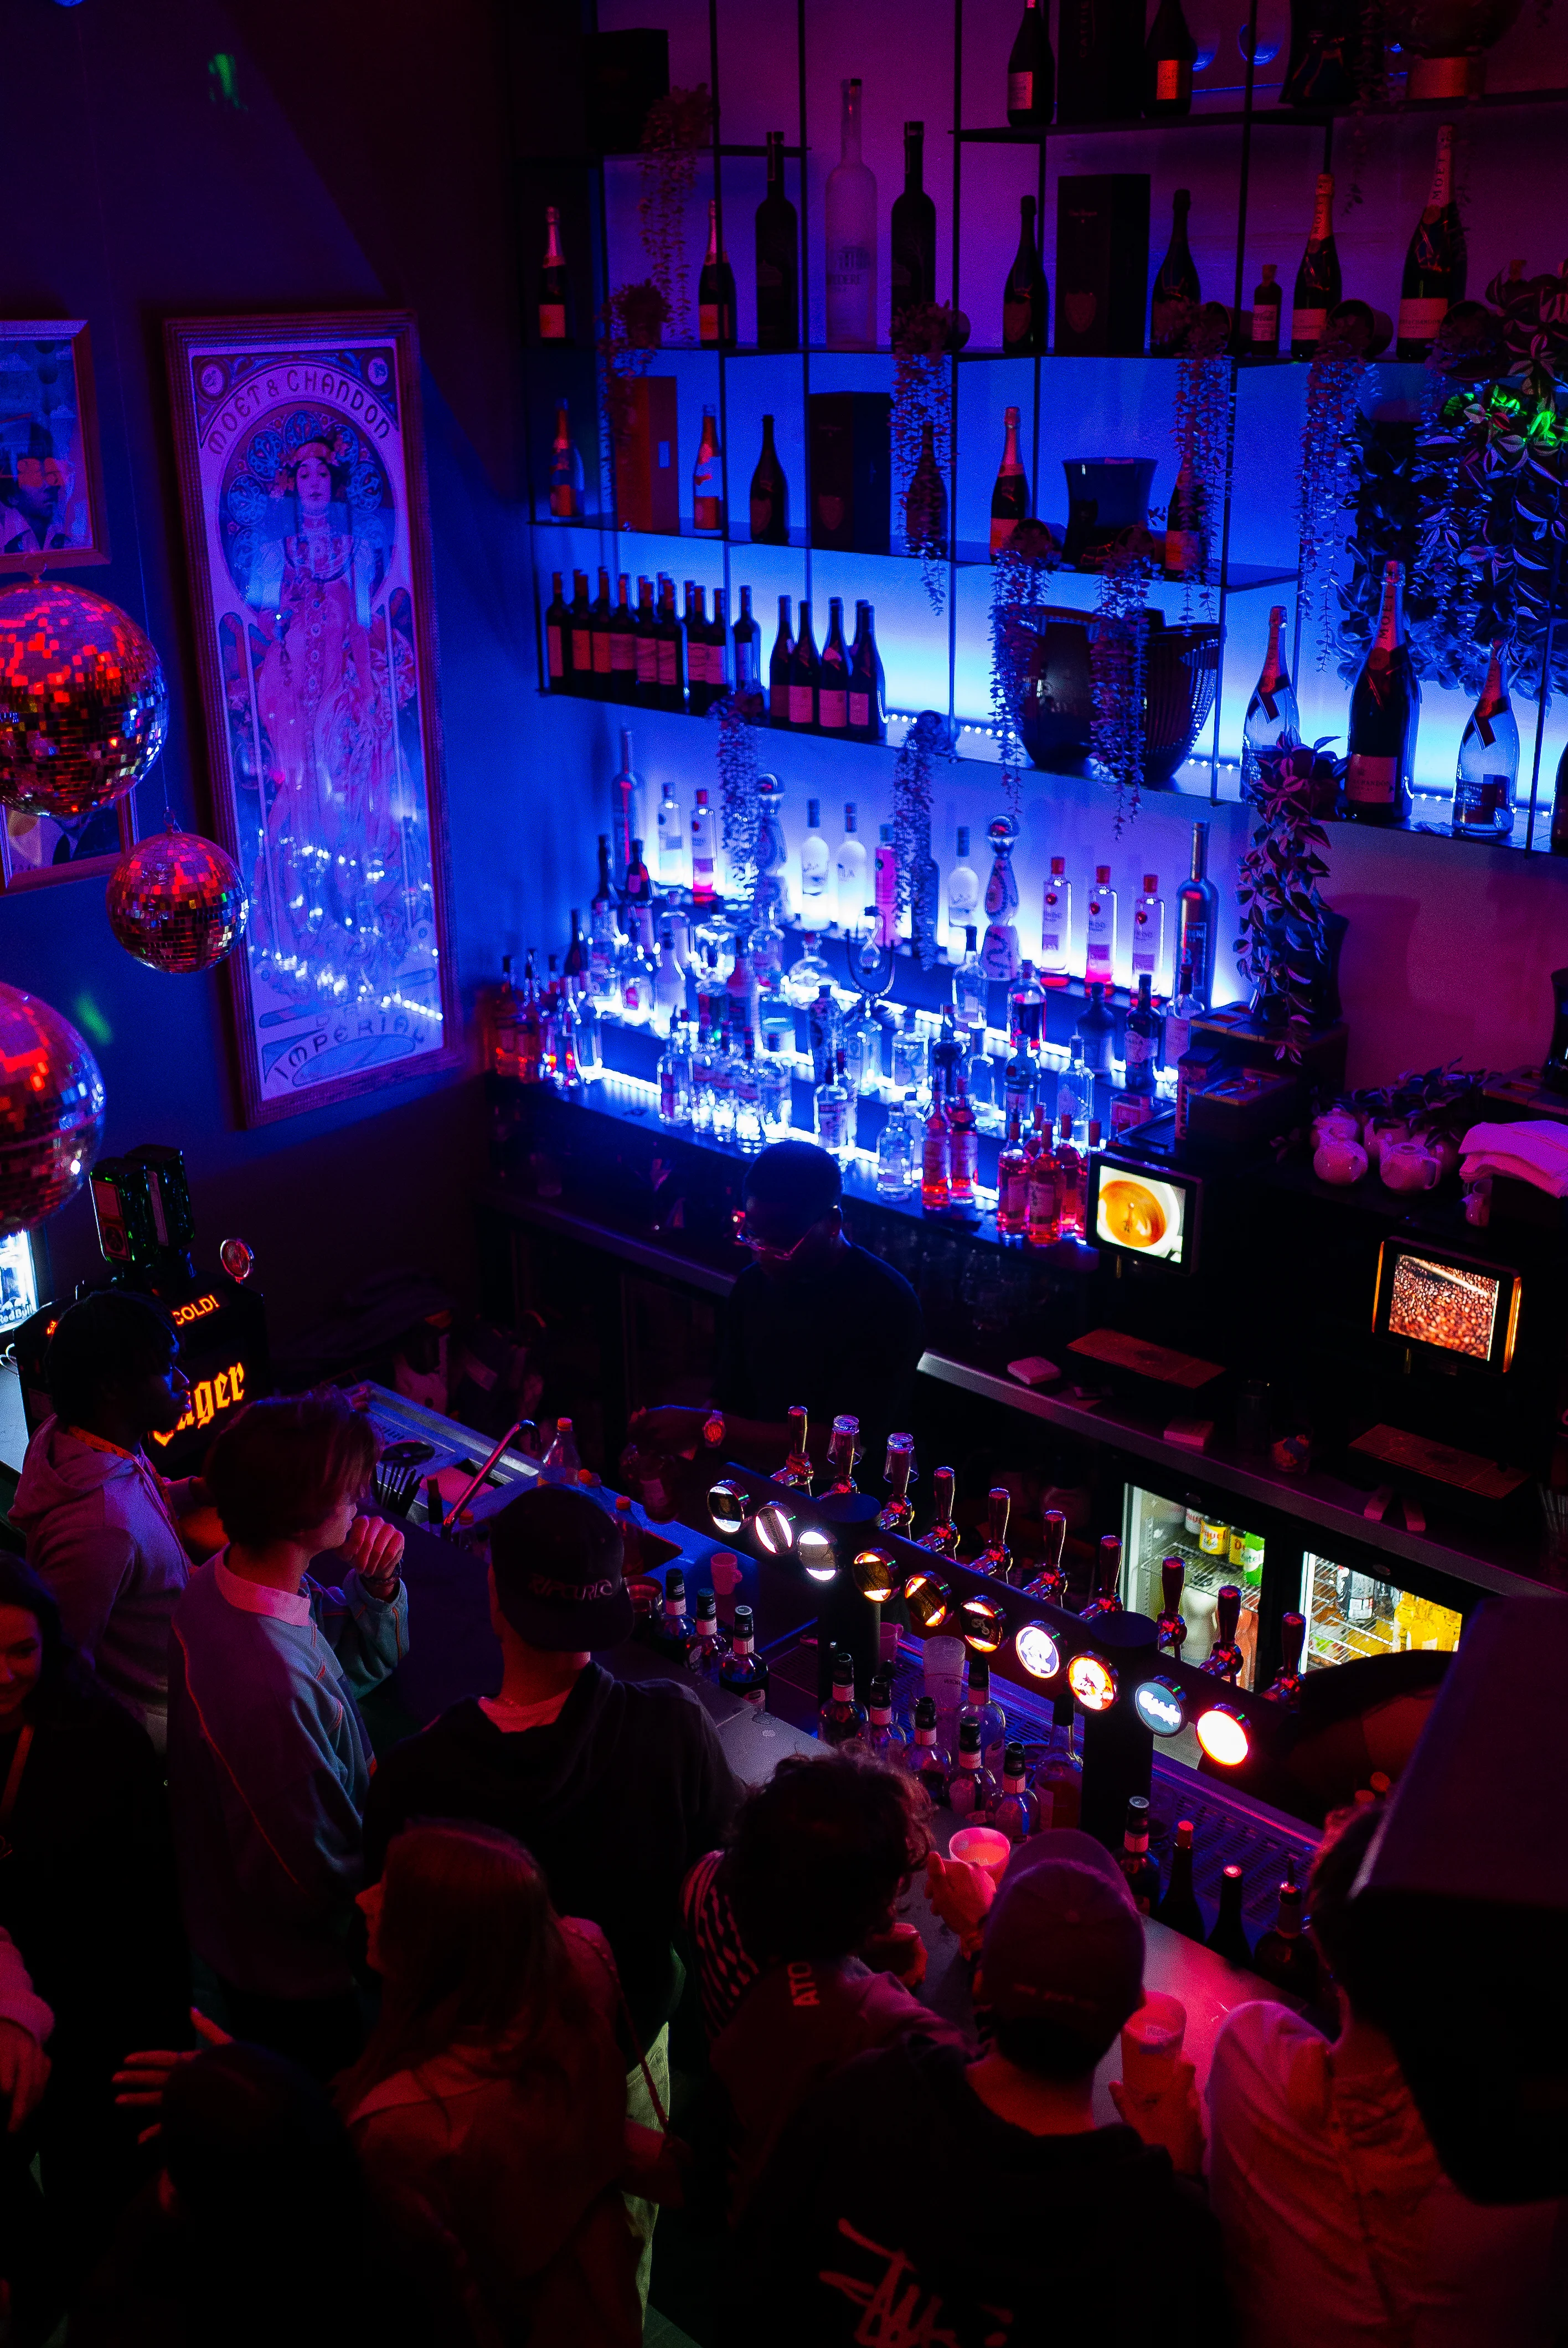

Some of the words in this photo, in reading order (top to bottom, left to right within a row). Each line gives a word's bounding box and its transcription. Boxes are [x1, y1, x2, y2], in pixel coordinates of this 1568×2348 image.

[266, 379, 279, 397] &
[286, 370, 390, 438] CHANDON
[275, 1013, 425, 1080] IMPERIAL
[16, 1304, 33, 1320] Bull
[172, 1294, 220, 1325] COLD!
[153, 1362, 245, 1446] ger
